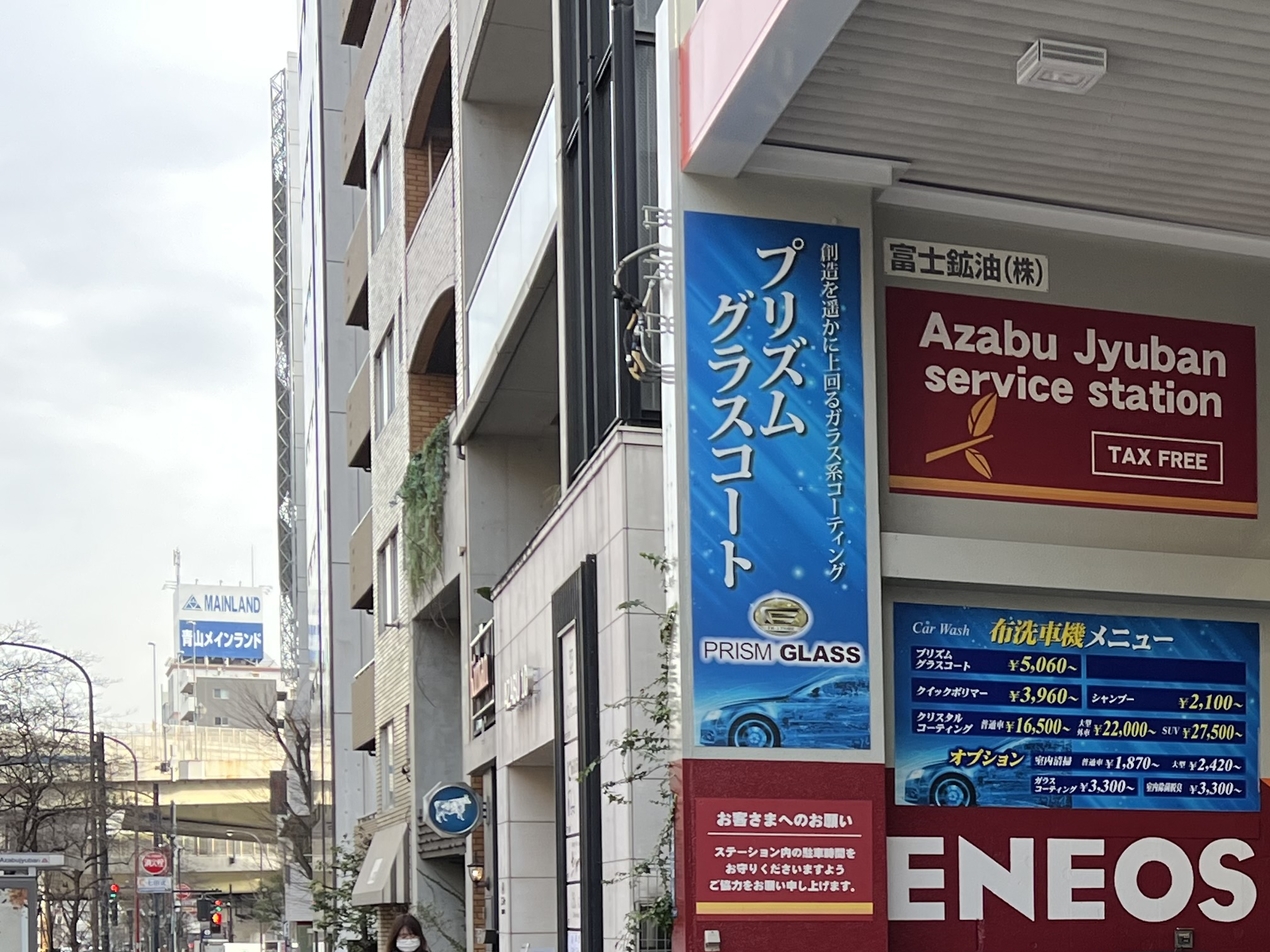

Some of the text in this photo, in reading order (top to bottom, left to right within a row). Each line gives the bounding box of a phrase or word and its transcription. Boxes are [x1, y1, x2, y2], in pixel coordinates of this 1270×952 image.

[756, 237, 808, 438] プリズム
[919, 311, 1227, 378] Azabu Jyuban
[924, 364, 1223, 418] service station
[820, 242, 846, 583] 創造を遥かに上回るガラス系コーティング
[708, 290, 754, 589] グラスコート
[1108, 445, 1209, 471] TAX FREE
[204, 594, 261, 613] MAINLAND
[912, 622, 970, 636] Car Wash
[989, 618, 1174, 651] 布洗車機メニュー
[182, 629, 261, 649] 青山メインランド
[703, 641, 861, 664] PRISM GLASS
[915, 659, 971, 671] グラスコート
[916, 712, 964, 723] クリスタル
[916, 723, 973, 735] コーティング
[1161, 726, 1180, 736] SUV
[949, 748, 1025, 767] オプション
[716, 811, 853, 829] お客さまへのお願い
[714, 846, 856, 859] ステーション内の駐車時間を
[725, 863, 845, 876] お守りくださいますよう
[709, 879, 856, 893] ご協力をお願い申し上げます。
[887, 836, 1258, 923] ENEOS
